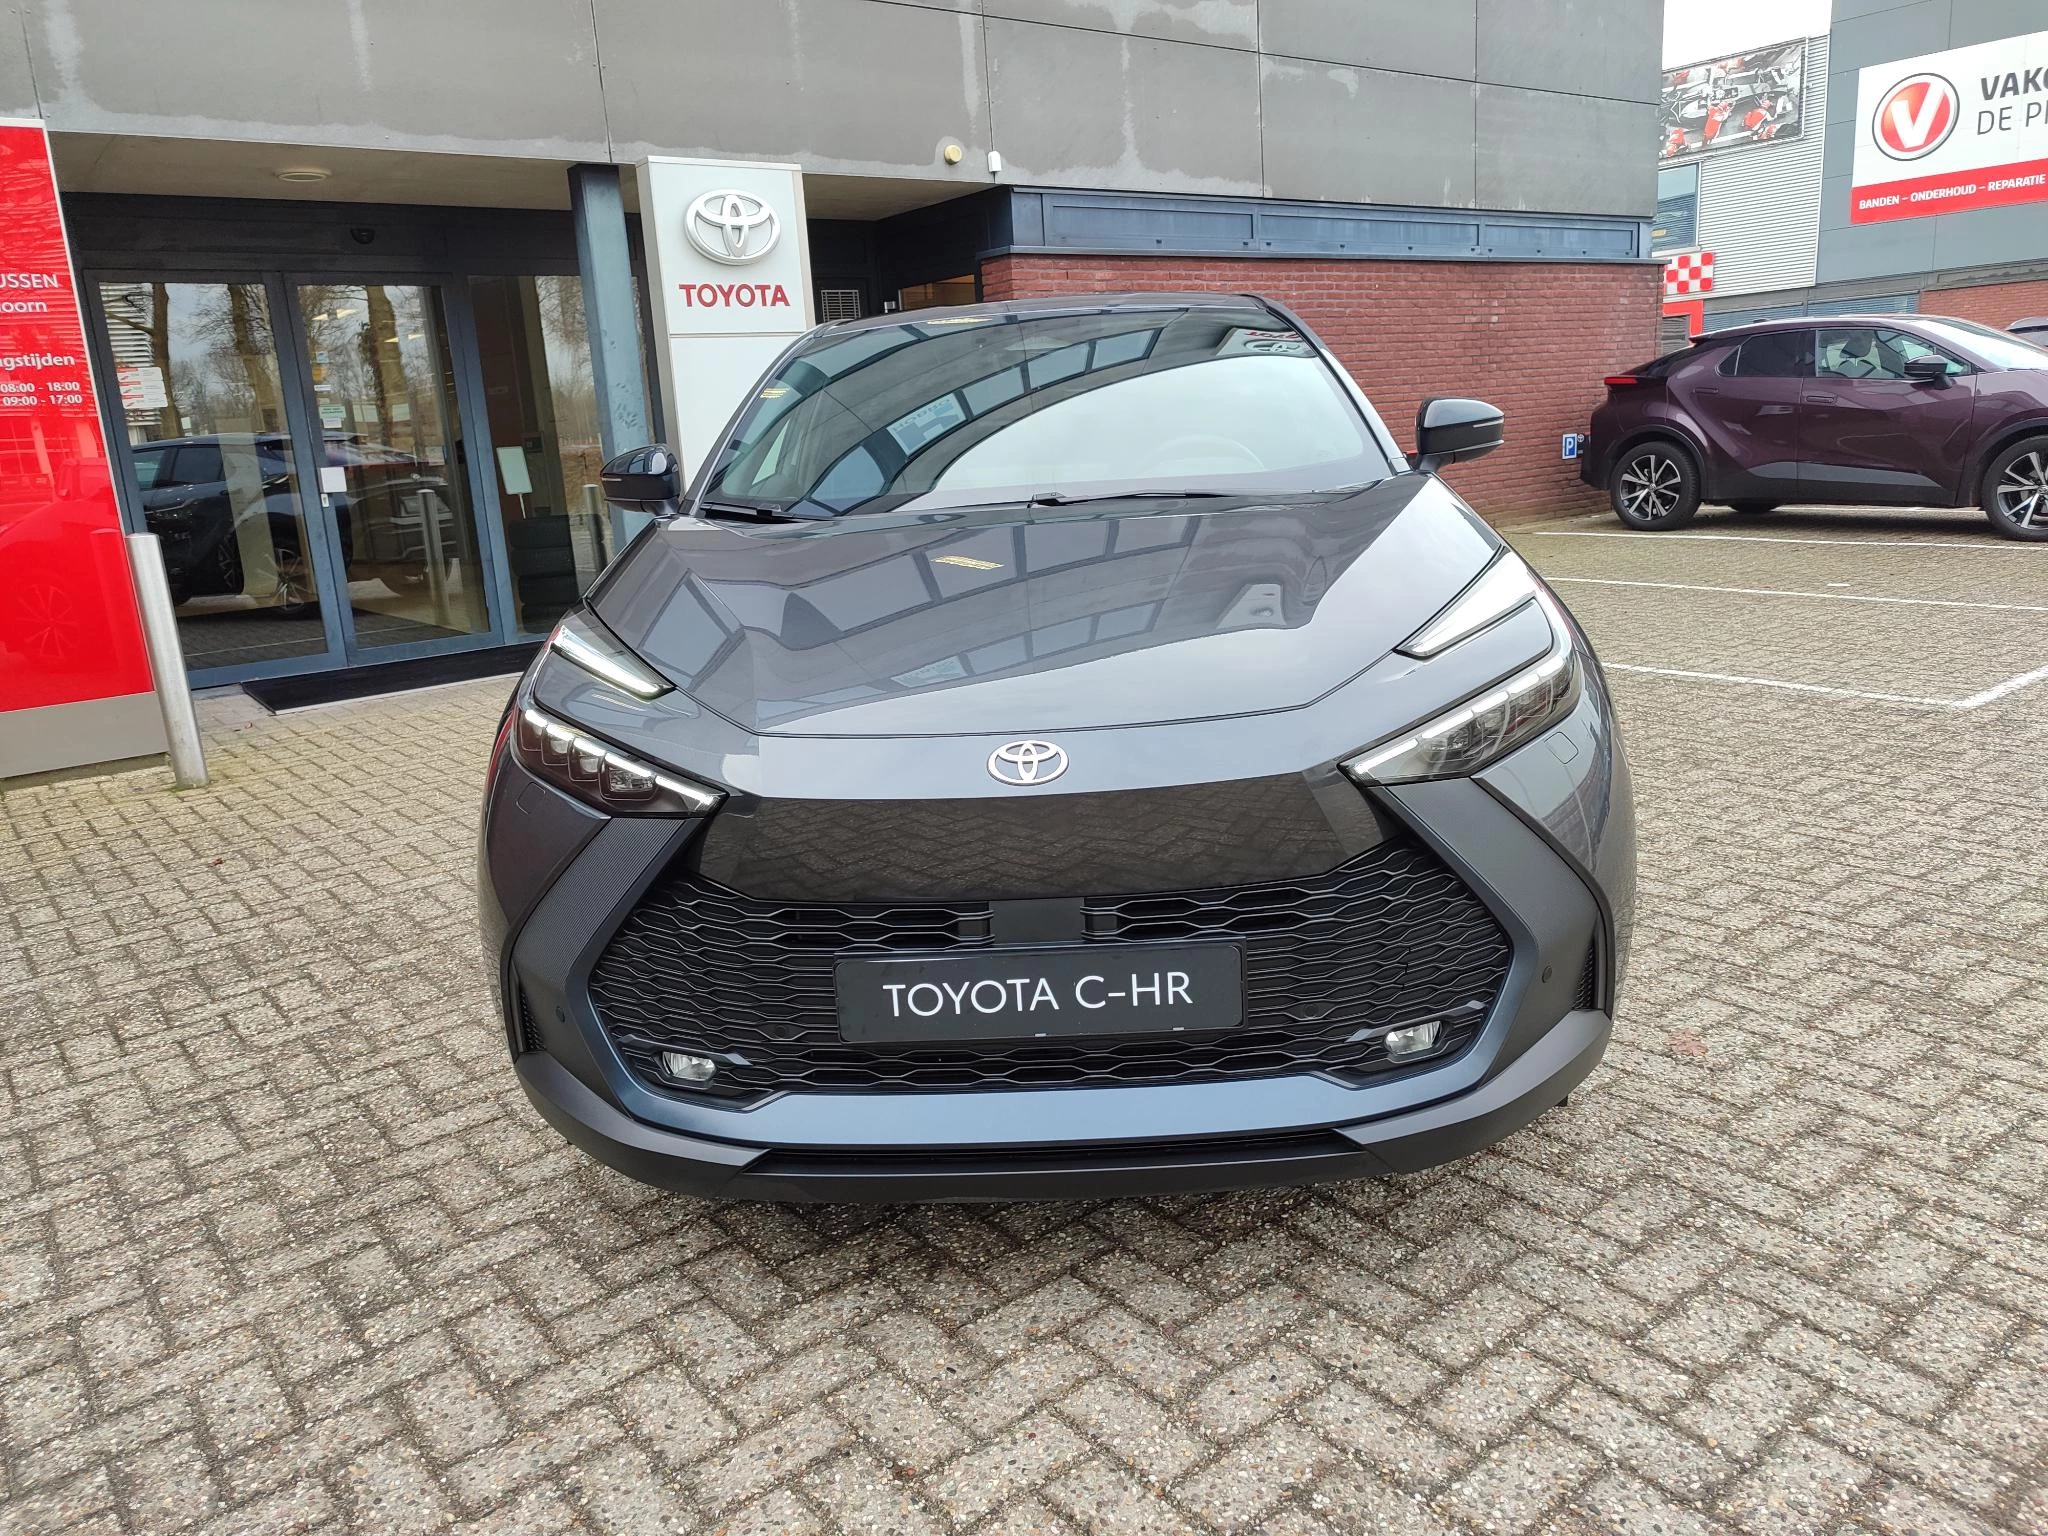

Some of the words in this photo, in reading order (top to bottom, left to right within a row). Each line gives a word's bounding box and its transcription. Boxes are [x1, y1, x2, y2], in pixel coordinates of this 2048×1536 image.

[1976, 106, 2013, 136] DE
[2025, 101, 2048, 128] P
[1859, 194, 1900, 210] BANDEN
[1910, 184, 1977, 203] ONDERHOUD
[1988, 173, 2046, 192] REPARATIE
[679, 283, 791, 308] TOYOTA
[0, 301, 48, 313] oorn
[0, 352, 76, 371] gstijden
[0, 382, 36, 393] 08:00
[46, 381, 81, 392] 18:00
[2, 395, 38, 406] 09:00
[49, 394, 83, 405] 17:00
[1566, 438, 1574, 455] P
[882, 977, 1060, 1018] TOYOTA
[1075, 971, 1194, 1009] C-HR
